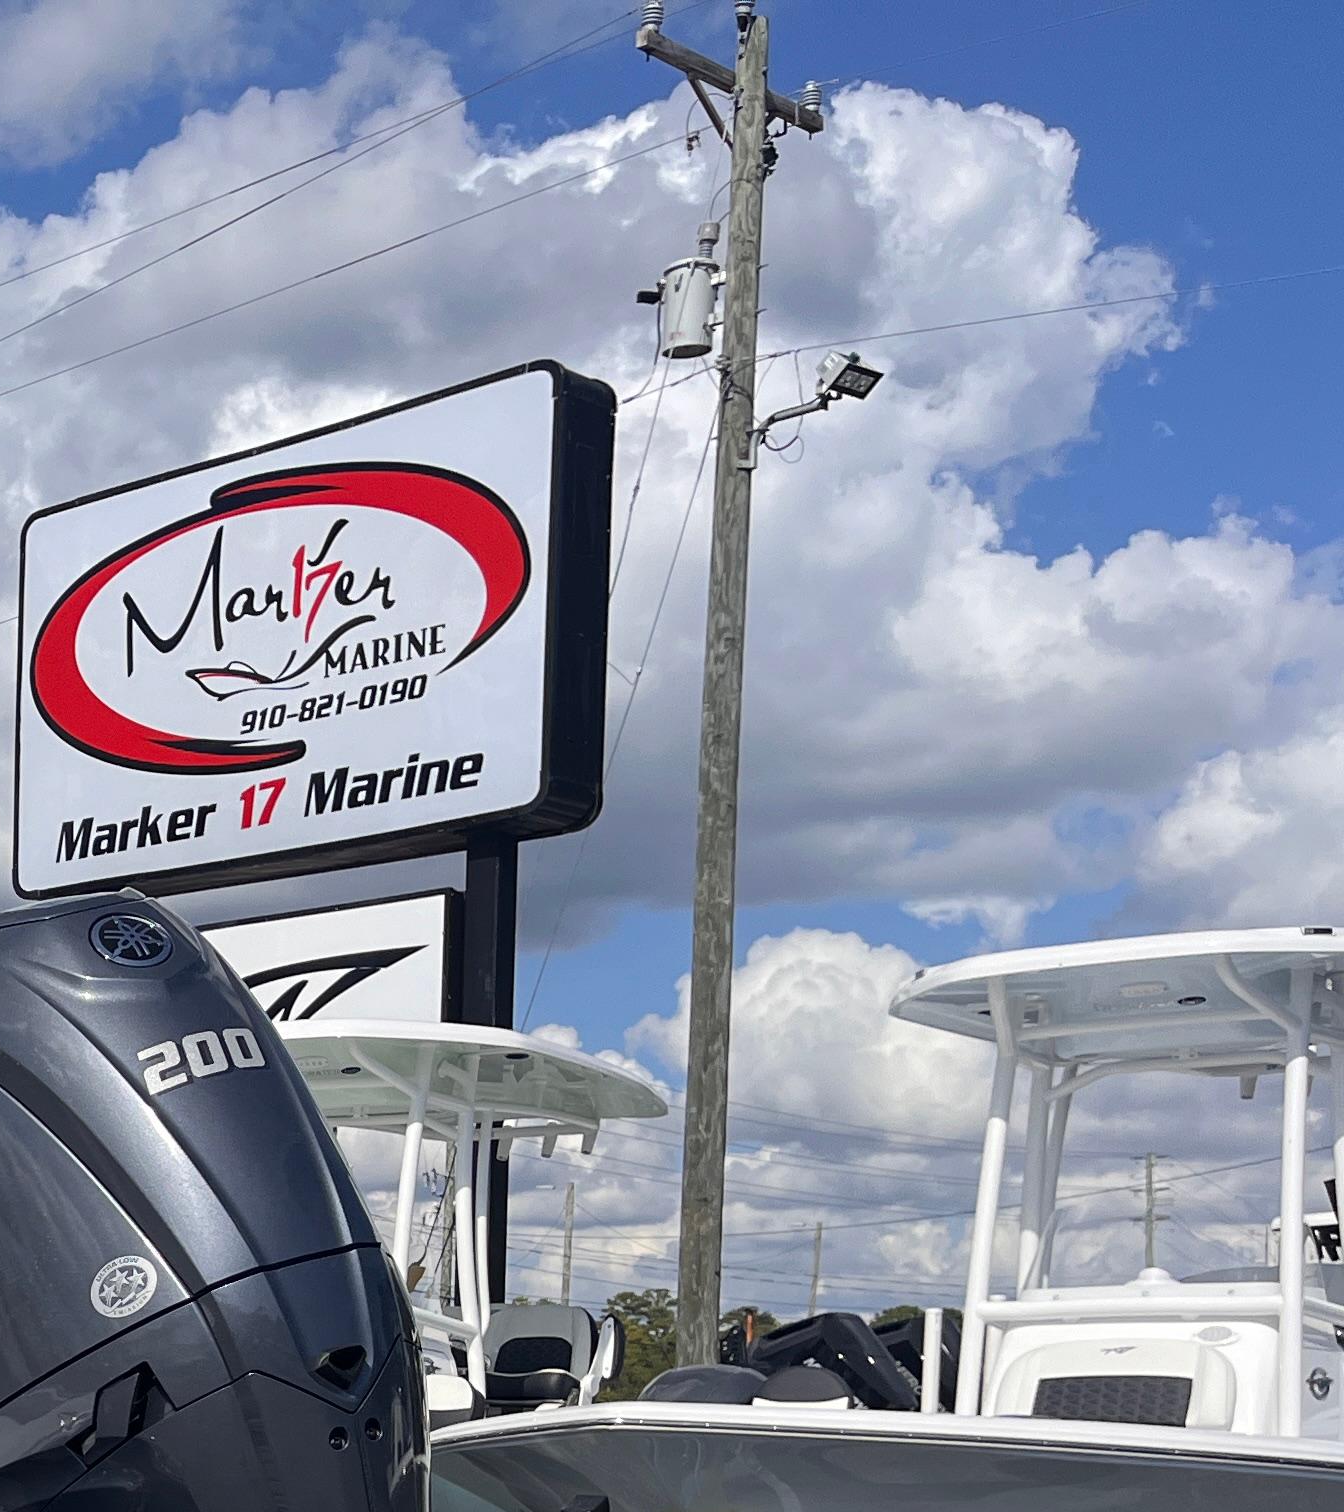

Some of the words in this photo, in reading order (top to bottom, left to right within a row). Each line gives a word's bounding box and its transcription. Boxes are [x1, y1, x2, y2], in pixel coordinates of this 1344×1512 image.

[323, 624, 447, 679] MARINE
[240, 673, 428, 735] 910-821-0190
[55, 803, 217, 864] Marker
[240, 777, 287, 830] 17
[304, 753, 484, 818] Marine
[136, 1027, 267, 1097] 200
